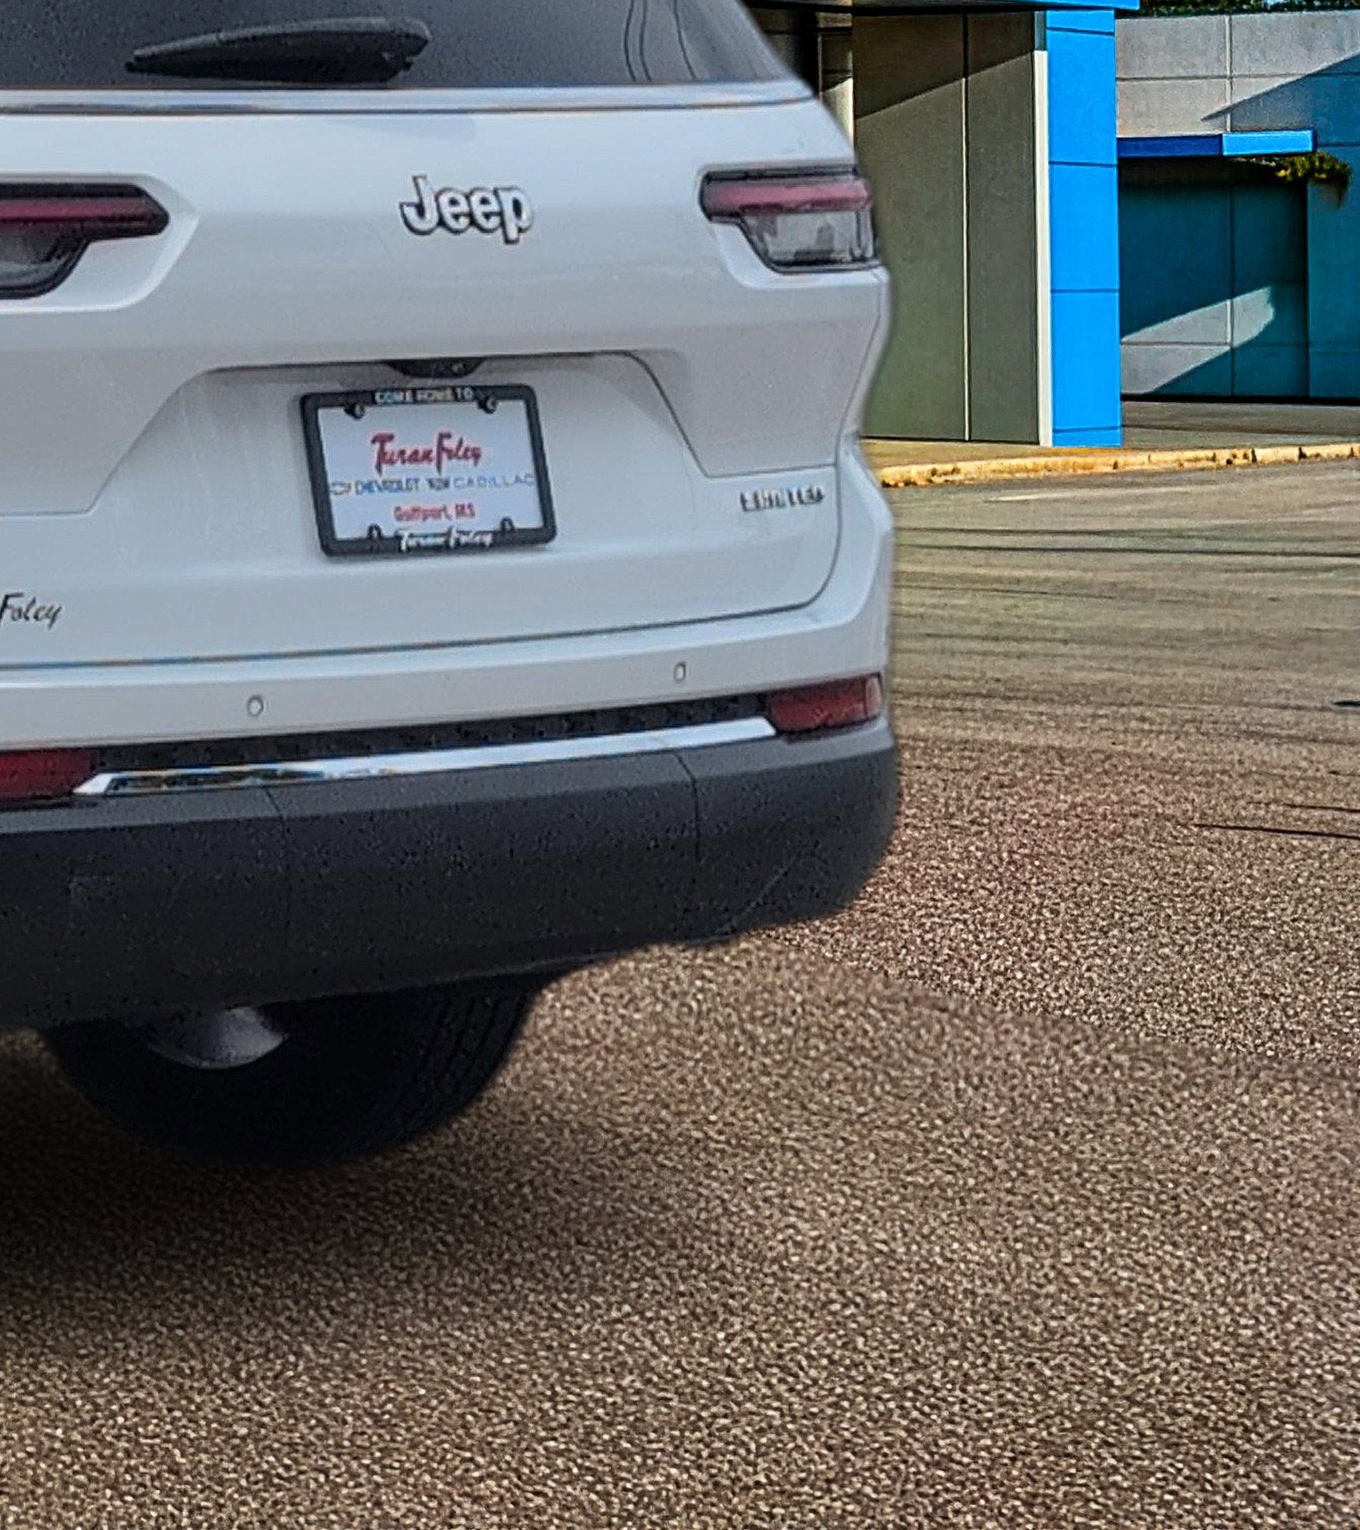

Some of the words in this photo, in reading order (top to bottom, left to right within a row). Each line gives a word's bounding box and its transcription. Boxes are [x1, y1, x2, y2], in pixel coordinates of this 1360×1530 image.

[399, 174, 534, 245] Jeep
[370, 431, 433, 477] Turan
[434, 432, 483, 476] Foley
[453, 472, 536, 489] CADILLAC
